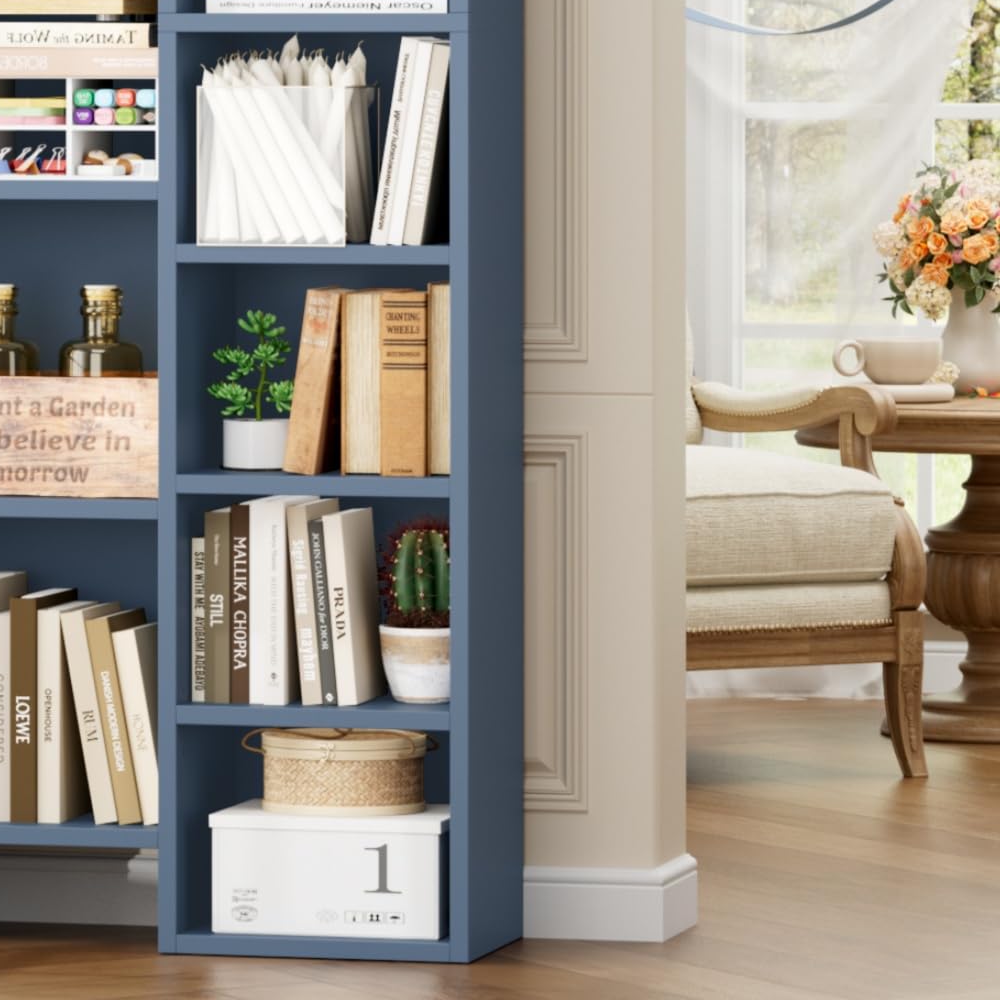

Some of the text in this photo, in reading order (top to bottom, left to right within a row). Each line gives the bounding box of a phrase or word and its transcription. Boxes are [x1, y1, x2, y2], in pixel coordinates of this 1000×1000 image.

[28, 400, 42, 417] a
[50, 396, 136, 418] Garden
[105, 429, 130, 452] in
[209, 594, 224, 628] STILL
[233, 536, 248, 670] MALLIKA CHOPRA
[334, 586, 346, 640] PRADA
[15, 695, 30, 744] LOEWE
[44, 688, 52, 742] OPENHOUSE
[363, 843, 403, 894] 1
